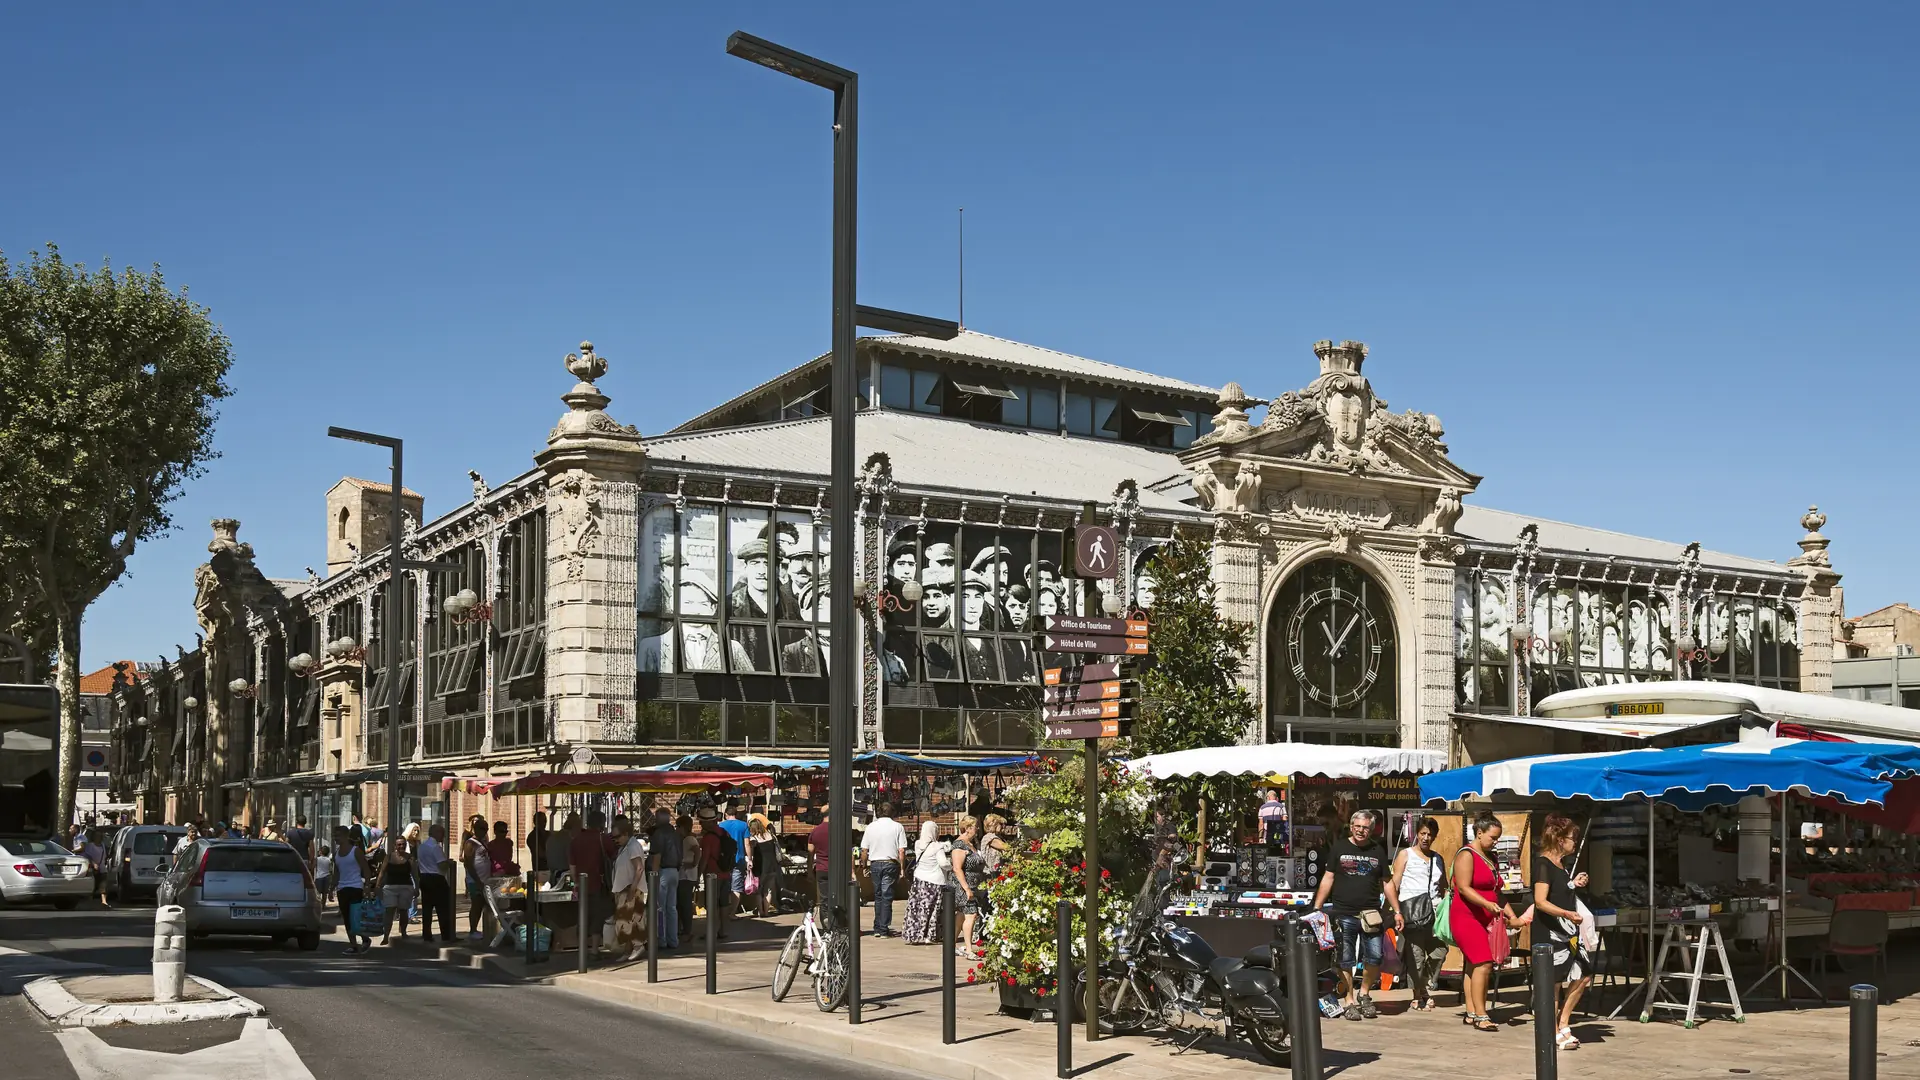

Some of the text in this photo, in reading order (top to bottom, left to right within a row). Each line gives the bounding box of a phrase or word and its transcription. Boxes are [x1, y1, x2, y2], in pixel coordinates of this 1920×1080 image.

[1061, 620, 1111, 631] Office de Tourisme
[1061, 640, 1097, 649] Hôtel de Ville
[1373, 776, 1411, 789] Power
[1368, 792, 1385, 800] STOP
